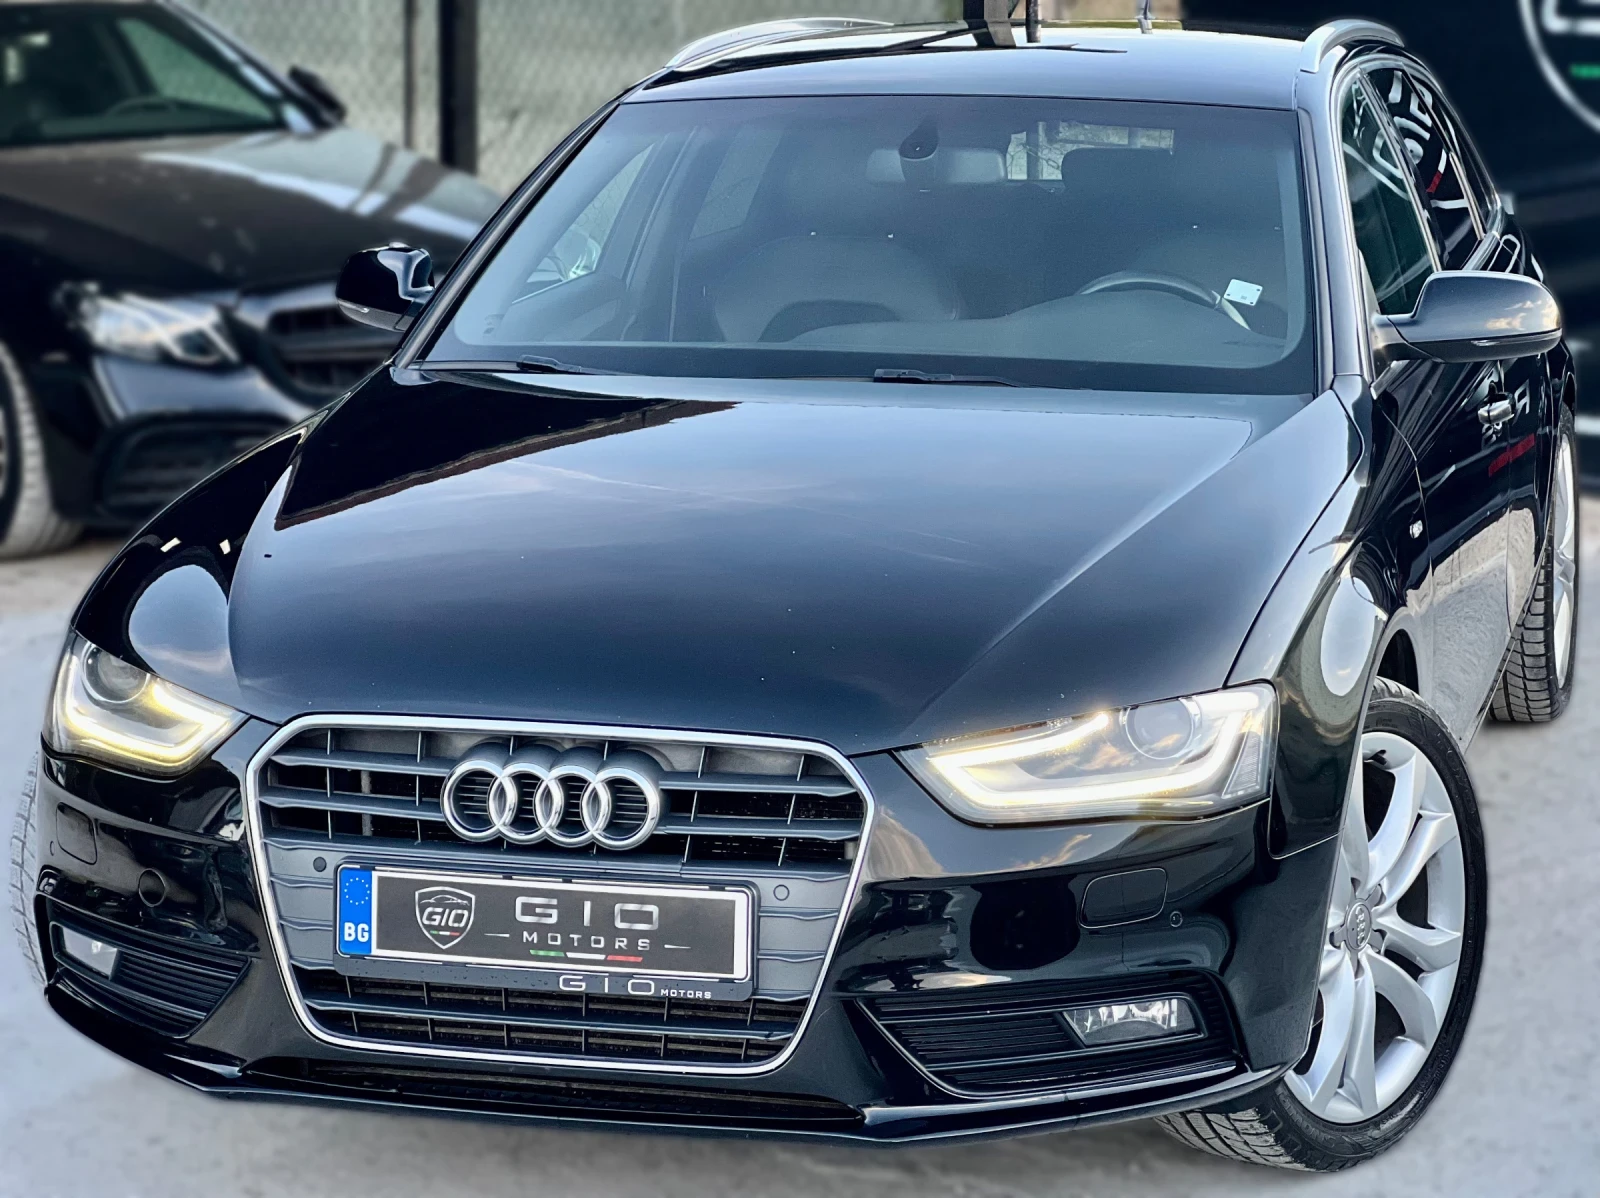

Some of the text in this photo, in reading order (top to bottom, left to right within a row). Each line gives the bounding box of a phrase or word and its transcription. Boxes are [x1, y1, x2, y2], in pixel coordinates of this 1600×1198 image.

[421, 906, 469, 928] GIO
[515, 896, 660, 931] GIO
[344, 921, 370, 943] BG
[522, 930, 651, 951] MOTORS
[558, 974, 712, 999] GIO MOTORS
